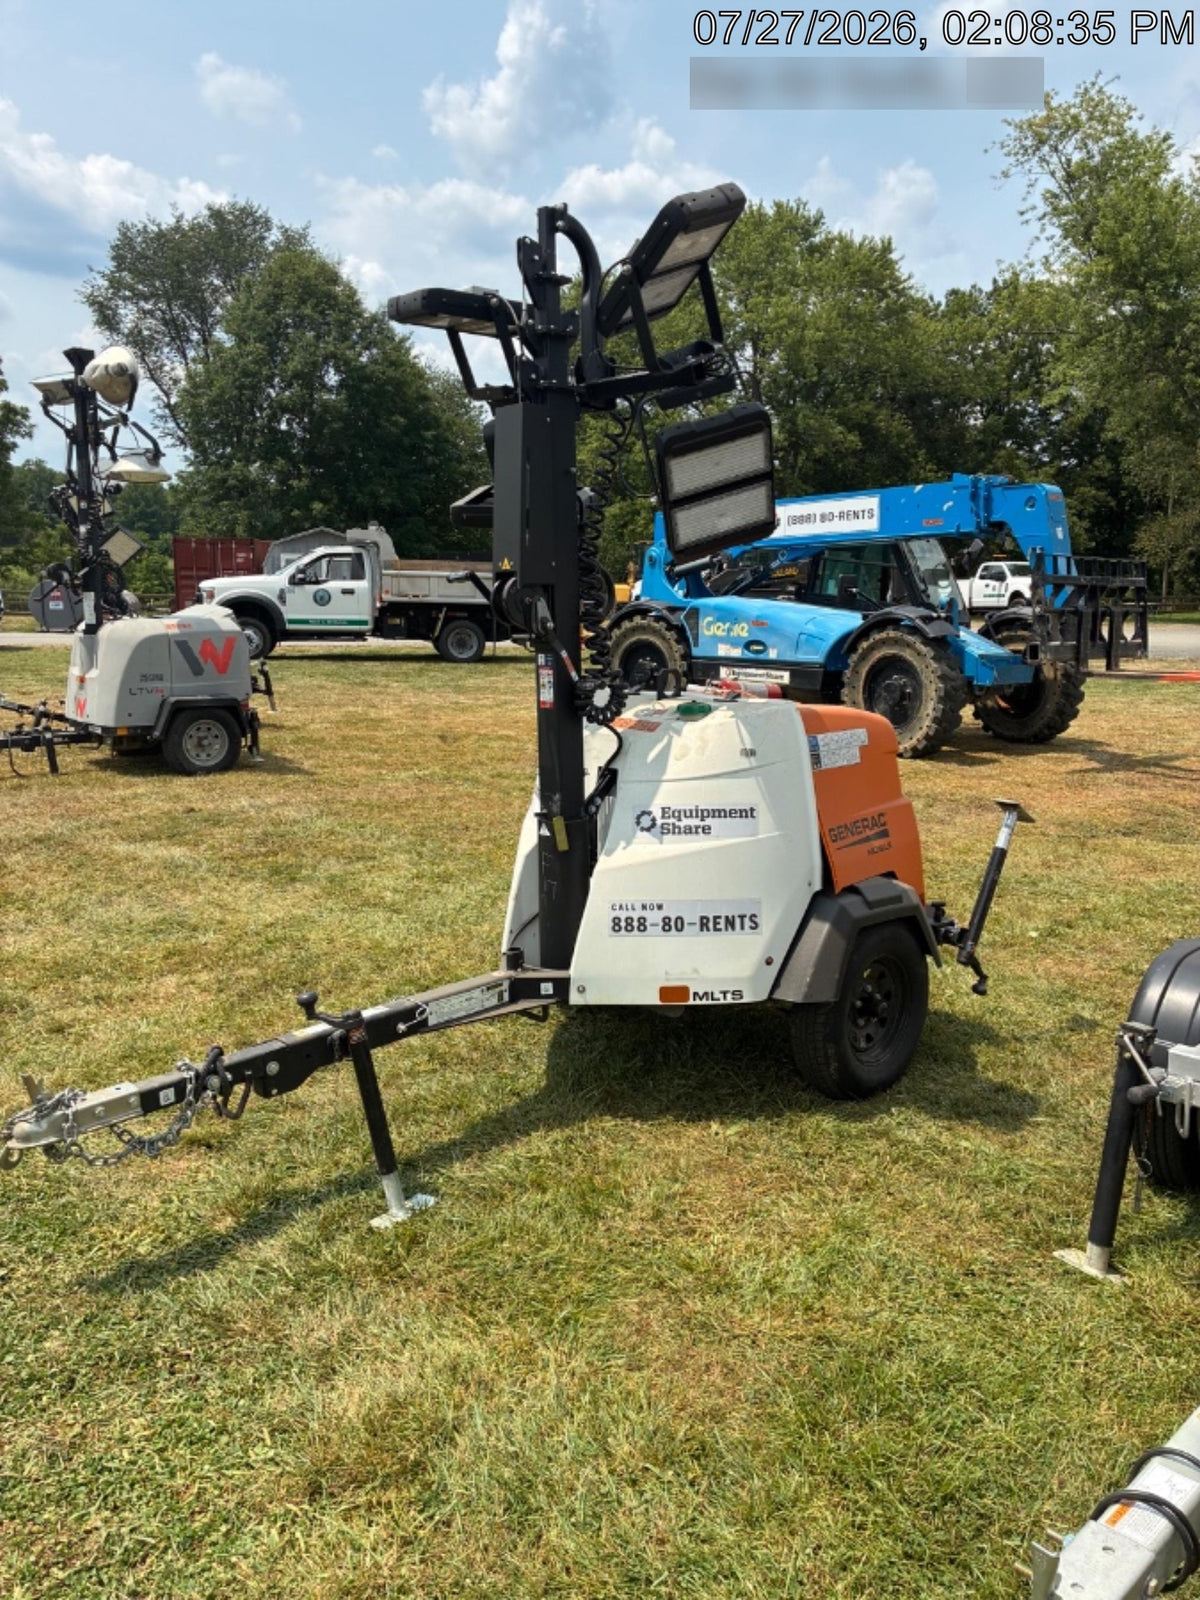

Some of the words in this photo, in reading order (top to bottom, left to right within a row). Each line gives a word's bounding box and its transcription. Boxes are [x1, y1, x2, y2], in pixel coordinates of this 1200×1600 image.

[660, 804, 757, 822] Equipment
[660, 822, 712, 836] Share
[828, 811, 888, 844] GENERAC
[611, 902, 637, 911] CALL
[641, 902, 664, 911] NOW
[610, 913, 760, 933] 888-80-RENTS
[692, 989, 744, 1002] MLTS
